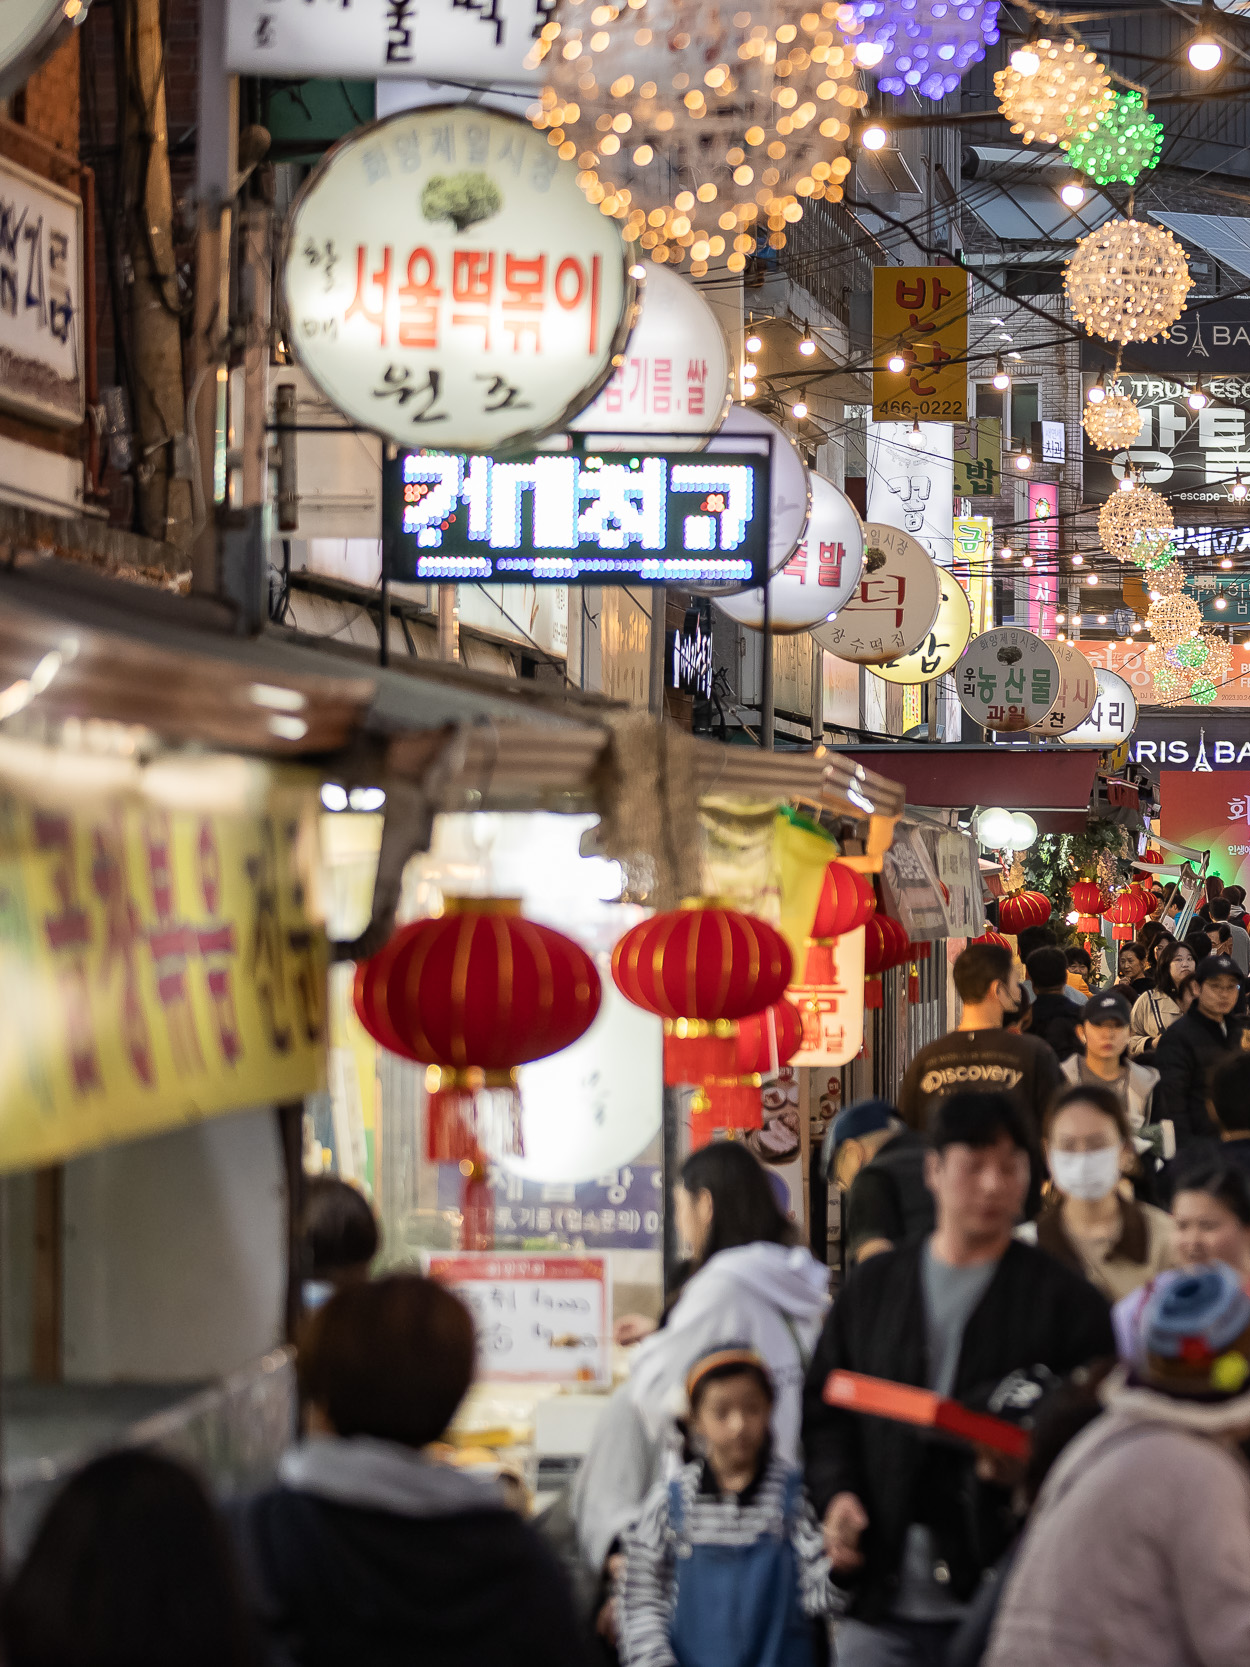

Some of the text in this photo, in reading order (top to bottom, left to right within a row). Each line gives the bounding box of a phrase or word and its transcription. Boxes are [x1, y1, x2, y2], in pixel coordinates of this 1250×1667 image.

[345, 245, 601, 356] 서울떡볶이
[373, 363, 536, 424] 원조
[879, 401, 962, 415] 466-0222
[1046, 440, 1063, 458] 치과
[980, 632, 1040, 653] 화양제일시장
[963, 668, 977, 698] 우리
[977, 667, 1051, 705] 농산물
[986, 705, 1027, 723] 과일
